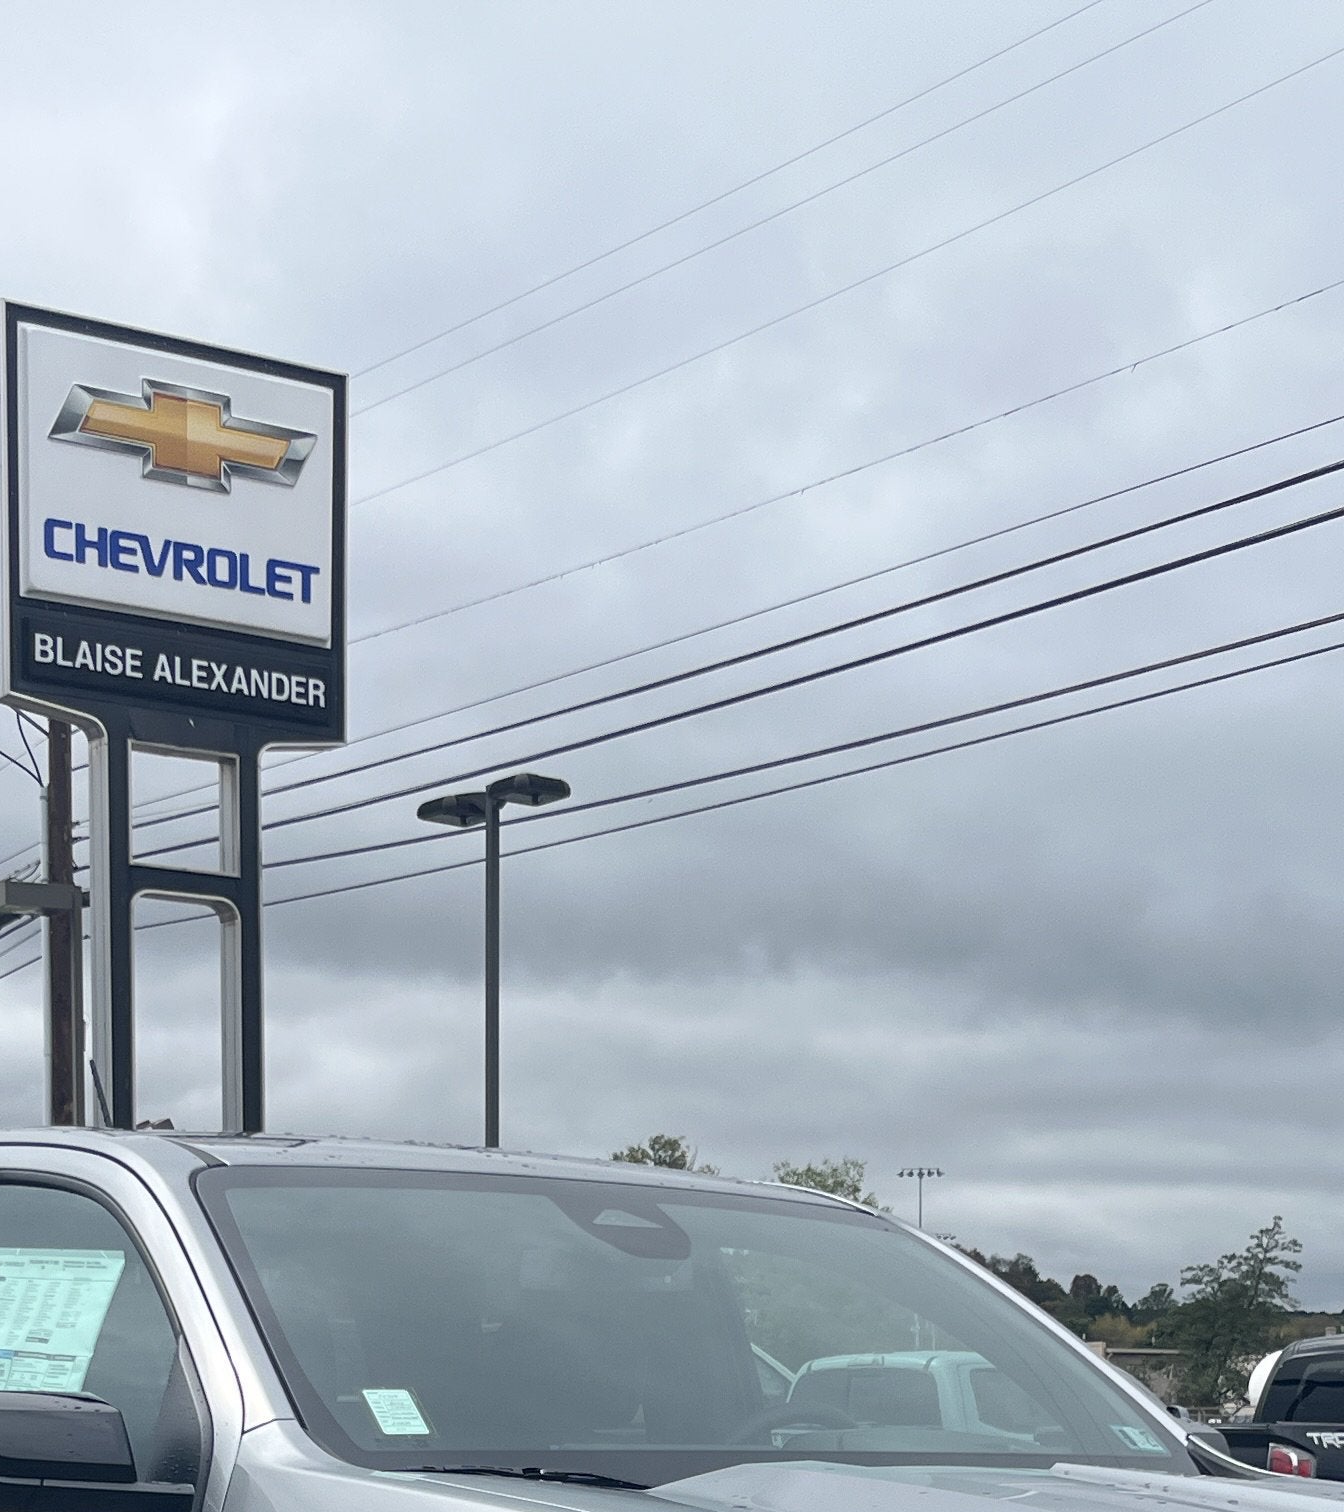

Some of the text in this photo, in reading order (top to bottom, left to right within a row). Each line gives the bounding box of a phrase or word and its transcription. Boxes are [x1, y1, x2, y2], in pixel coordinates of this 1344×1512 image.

[43, 517, 321, 605] CHEVROLET
[33, 632, 327, 709] BLAISE ALEXANDER
